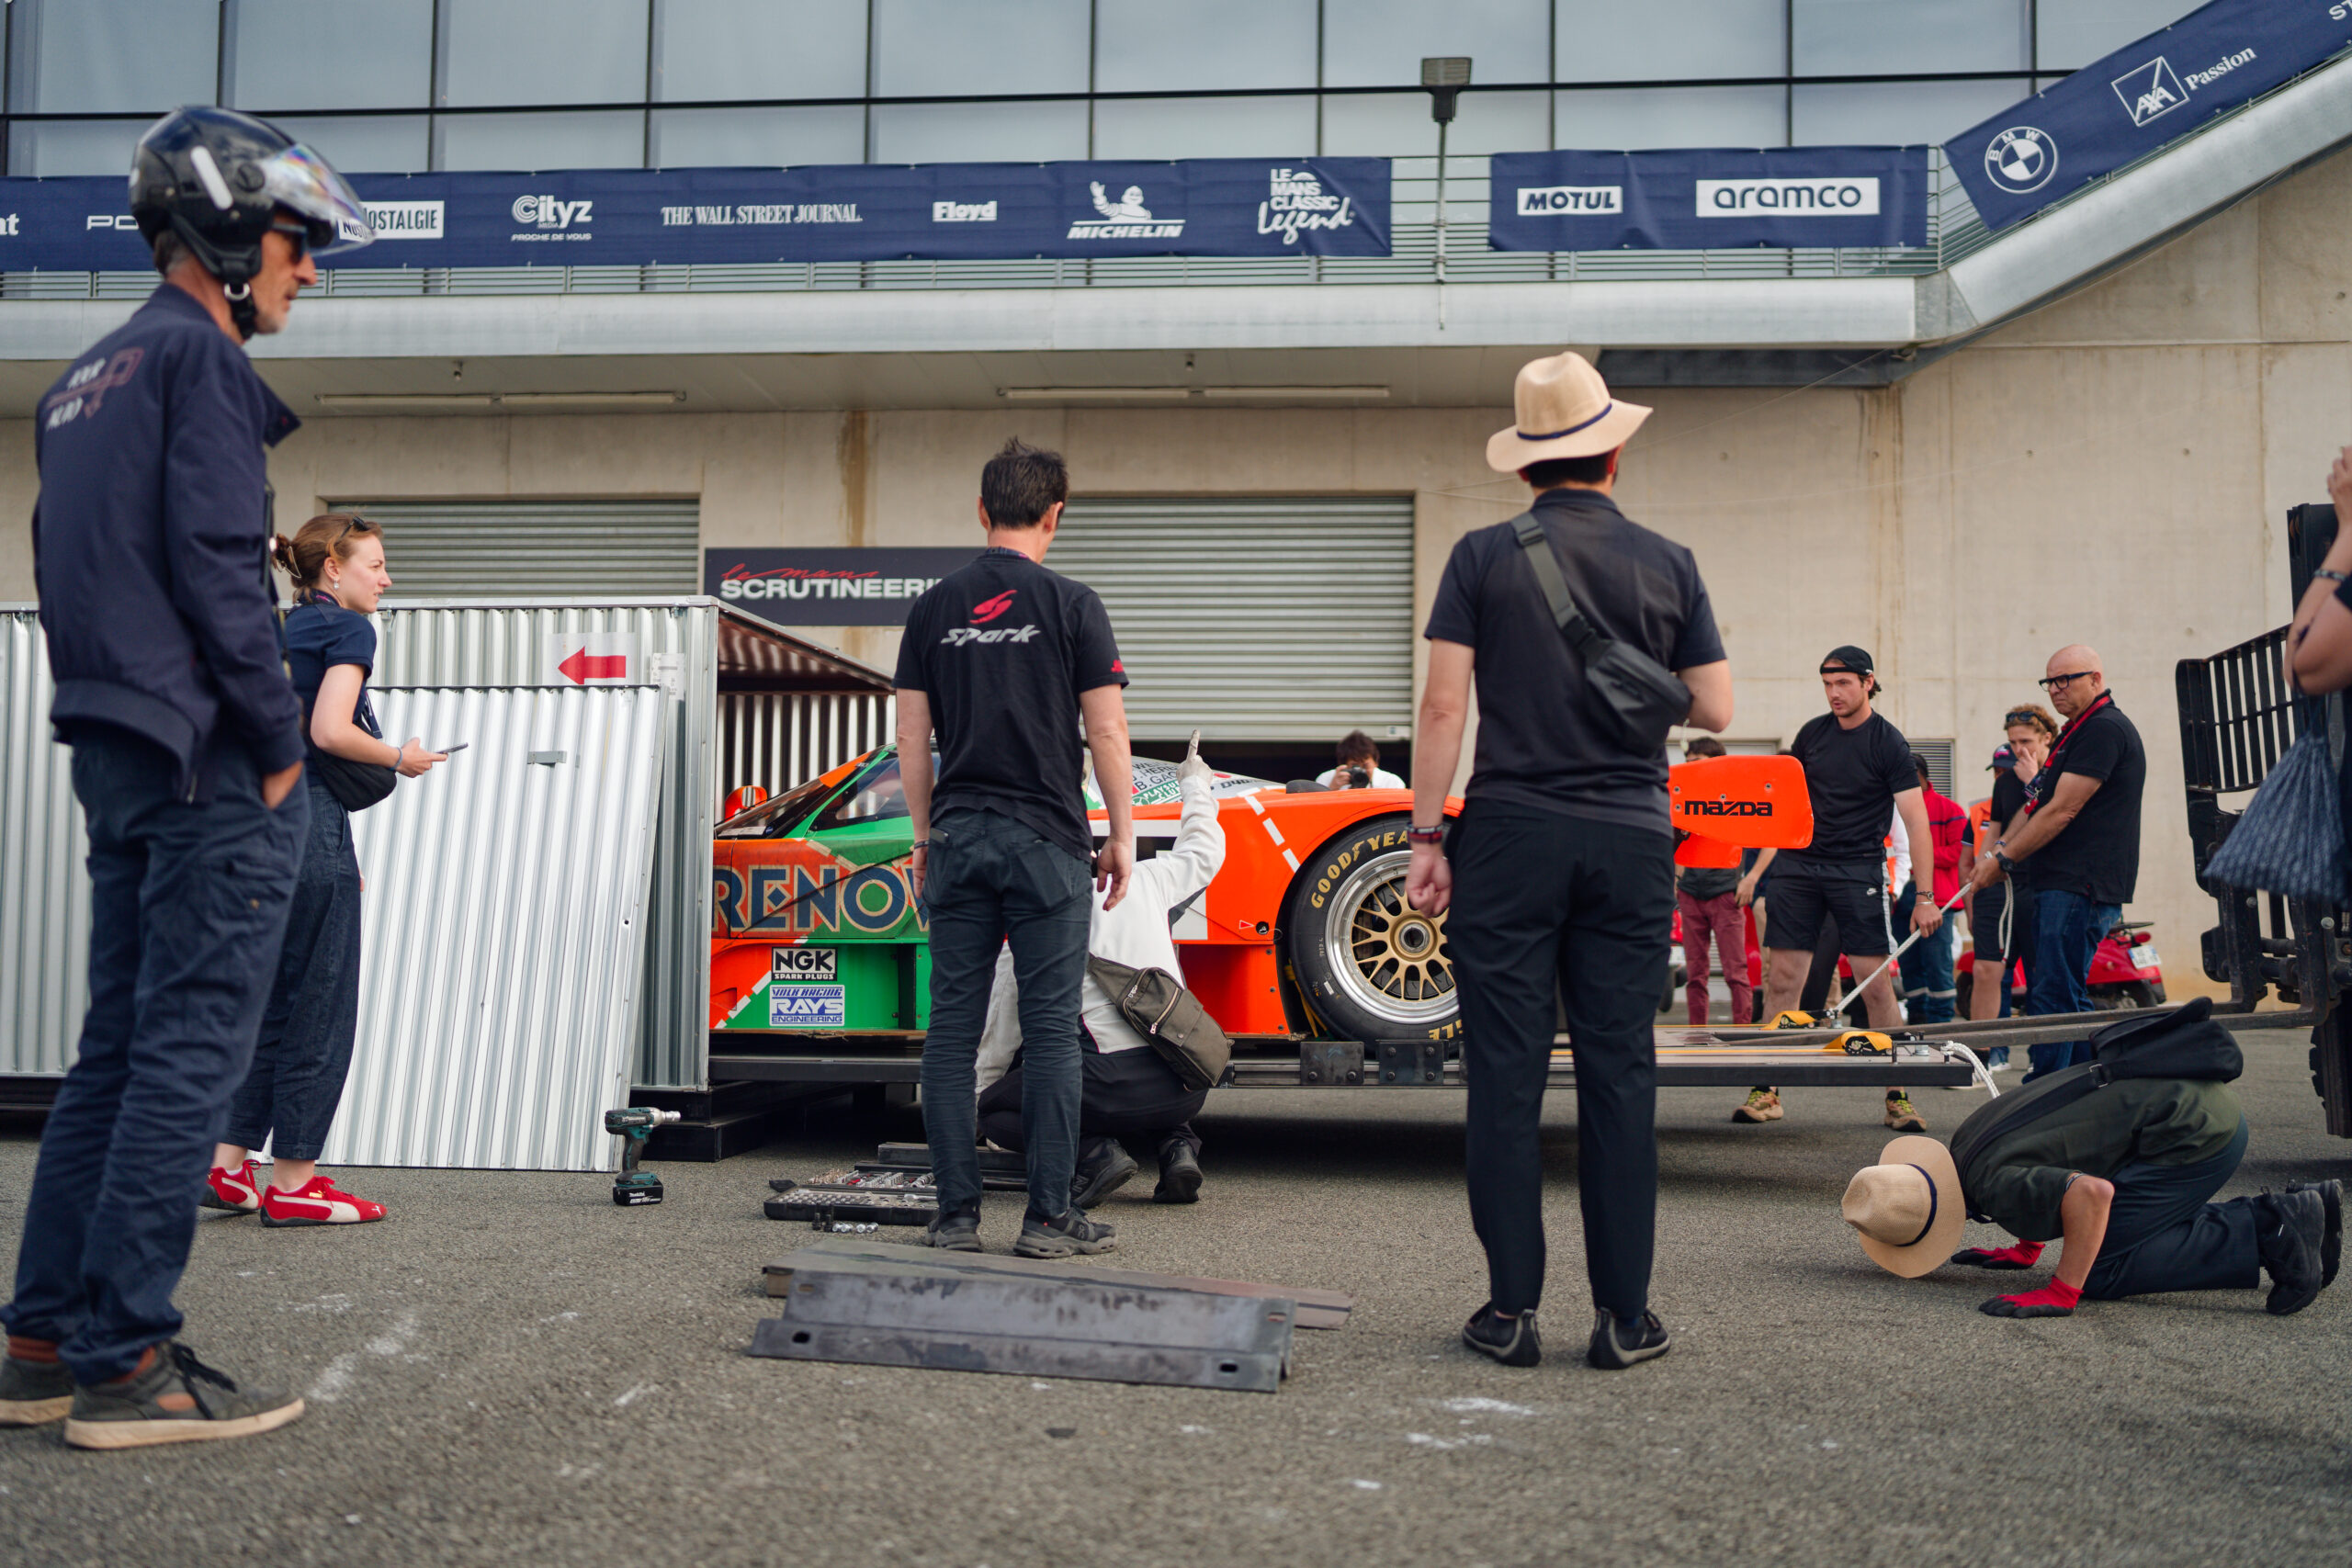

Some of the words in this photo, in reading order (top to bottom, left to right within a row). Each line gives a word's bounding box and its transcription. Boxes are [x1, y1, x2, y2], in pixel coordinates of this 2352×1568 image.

[2134, 85, 2178, 122] AXA
[2183, 47, 2257, 91] Passion
[1271, 168, 1293, 182] LE
[1271, 182, 1322, 196] MANS
[1713, 186, 1861, 209] aramco
[1270, 196, 1340, 210] CLASSIC
[1523, 190, 1615, 210] MOTUL
[363, 208, 437, 231] OSTALGIE
[512, 195, 594, 229] Cityz
[661, 206, 694, 226] THE
[695, 205, 735, 226] WALL
[736, 204, 795, 225] STREET
[933, 200, 998, 222] Floyd
[1257, 197, 1353, 245] Legend
[86, 214, 139, 231] PO
[1067, 224, 1184, 240] MICHELIN
[511, 233, 550, 242] PROCHE
[551, 233, 565, 242] DE
[566, 232, 593, 242] VOUS
[720, 578, 944, 600] SCRUTINEERI
[1149, 771, 1177, 784] GAC
[1684, 800, 1773, 817] mazda
[1311, 829, 1408, 908] GOODYEA
[775, 950, 833, 972] NGK
[772, 998, 842, 1014] RAYS
